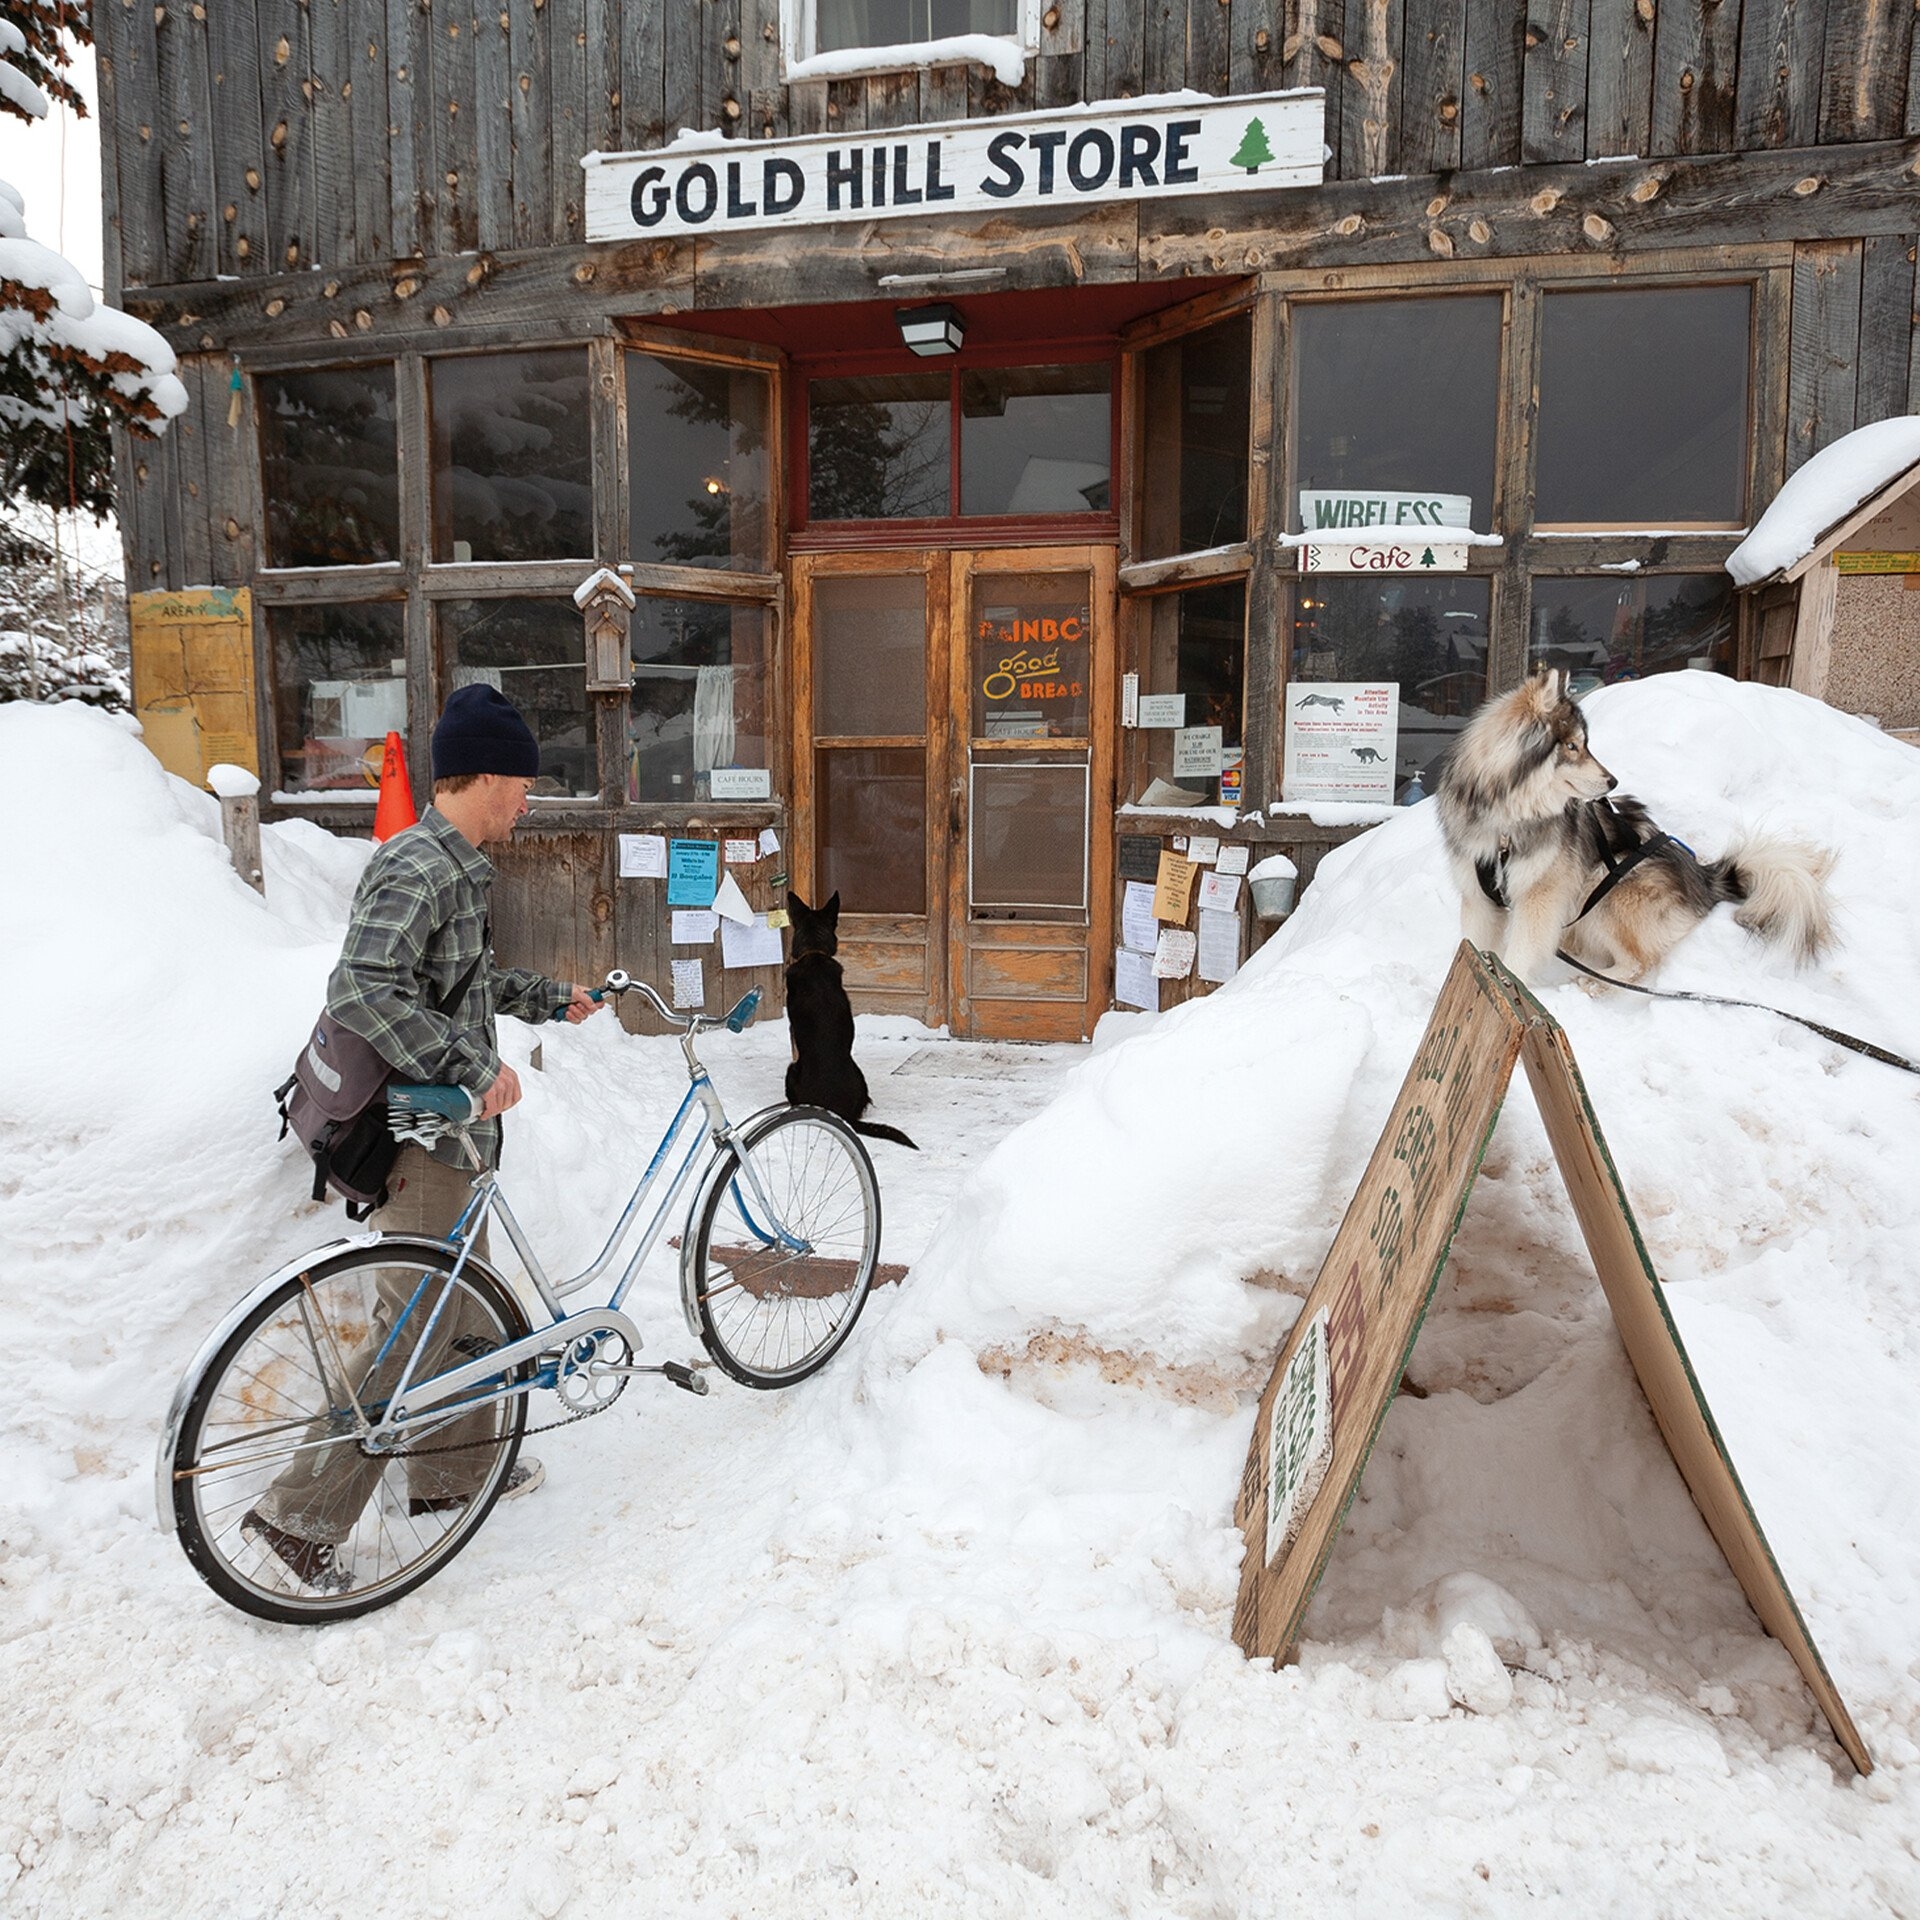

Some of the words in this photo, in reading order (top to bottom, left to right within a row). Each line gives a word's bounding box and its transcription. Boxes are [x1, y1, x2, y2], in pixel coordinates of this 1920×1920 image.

[630, 157, 804, 227] GOLD
[827, 141, 954, 210] HILL
[980, 120, 1202, 198] STORE
[1349, 546, 1414, 570] Cafe
[983, 647, 1060, 699] good
[1417, 1024, 1458, 1084] GOLD
[1445, 1044, 1473, 1174] HILL
[1393, 1104, 1437, 1252] GENERAL
[1370, 1185, 1403, 1313] STORE
[1328, 1260, 1368, 1430] OPEN
